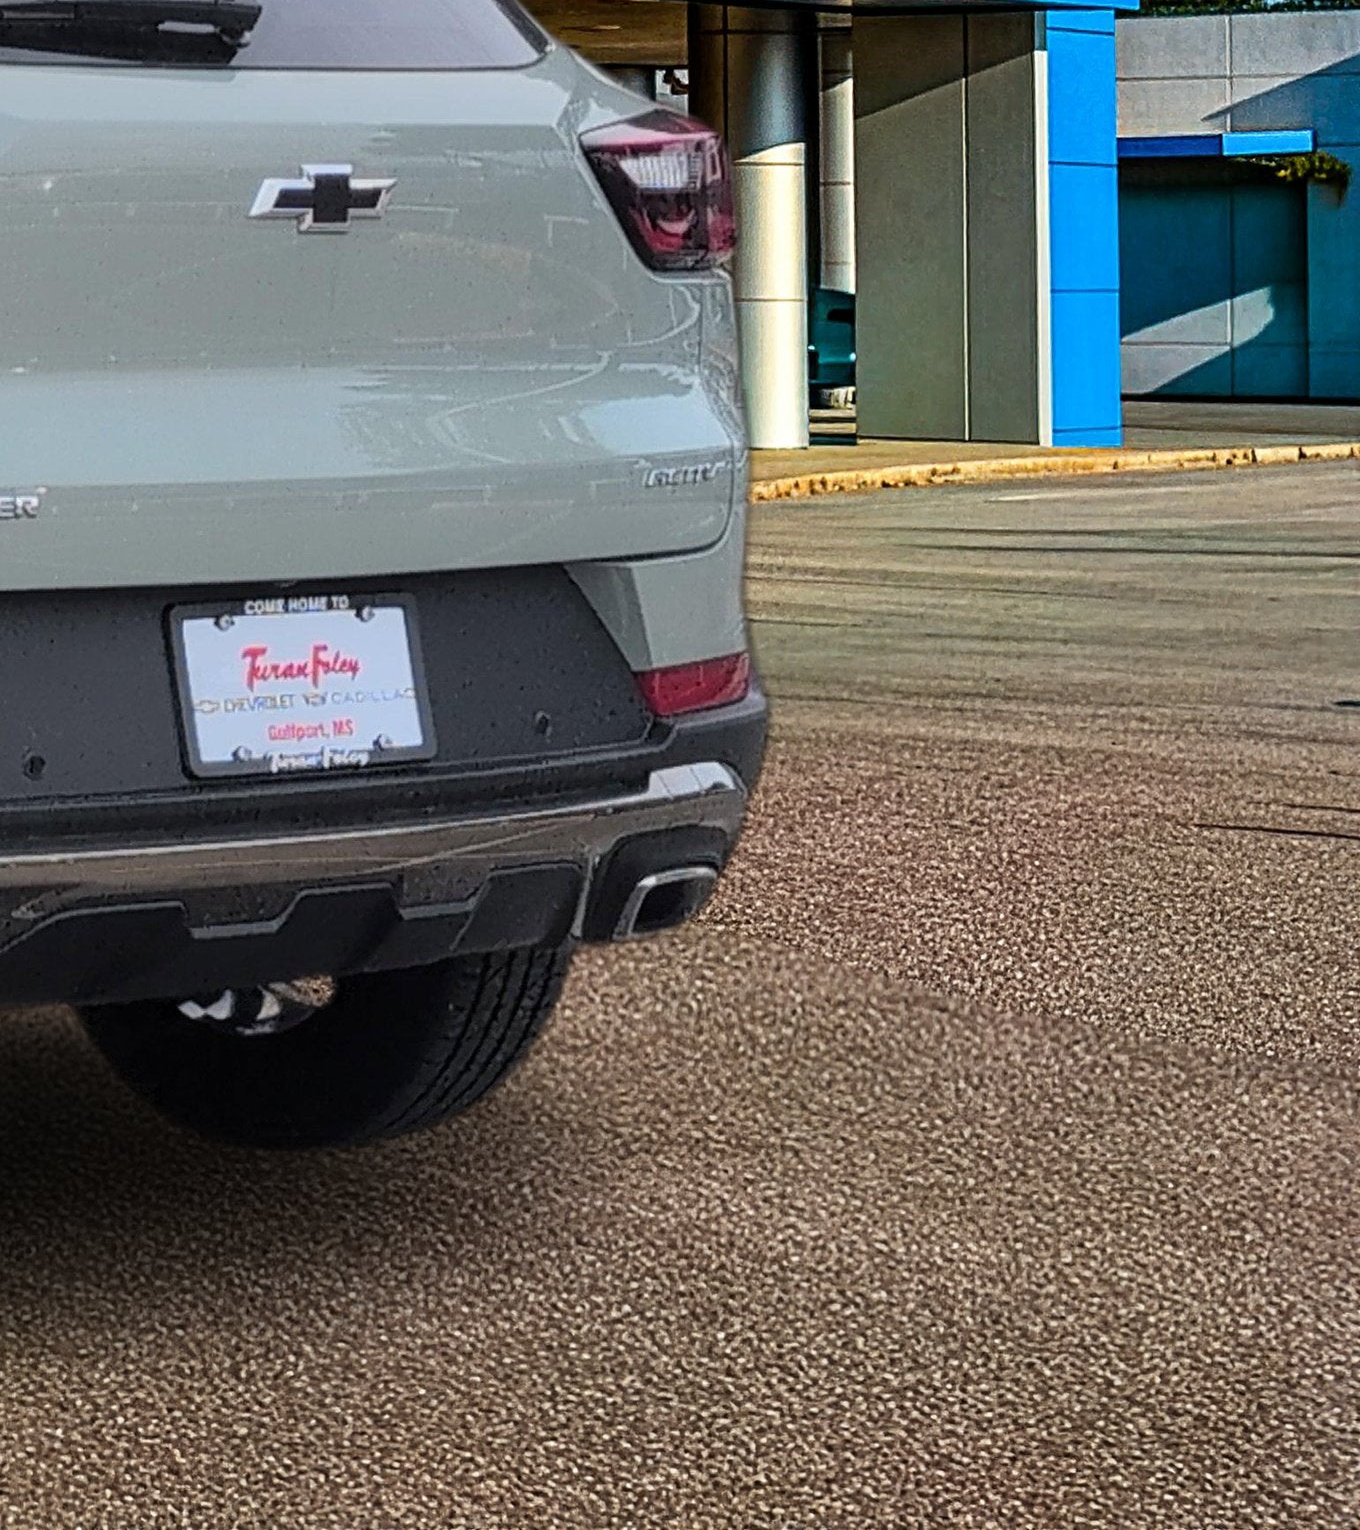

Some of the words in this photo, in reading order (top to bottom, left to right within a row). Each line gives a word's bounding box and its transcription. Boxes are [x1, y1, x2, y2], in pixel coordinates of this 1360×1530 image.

[244, 598, 285, 614] COME
[288, 596, 327, 612] HOME
[330, 594, 349, 609] TO
[333, 719, 353, 737] MS
